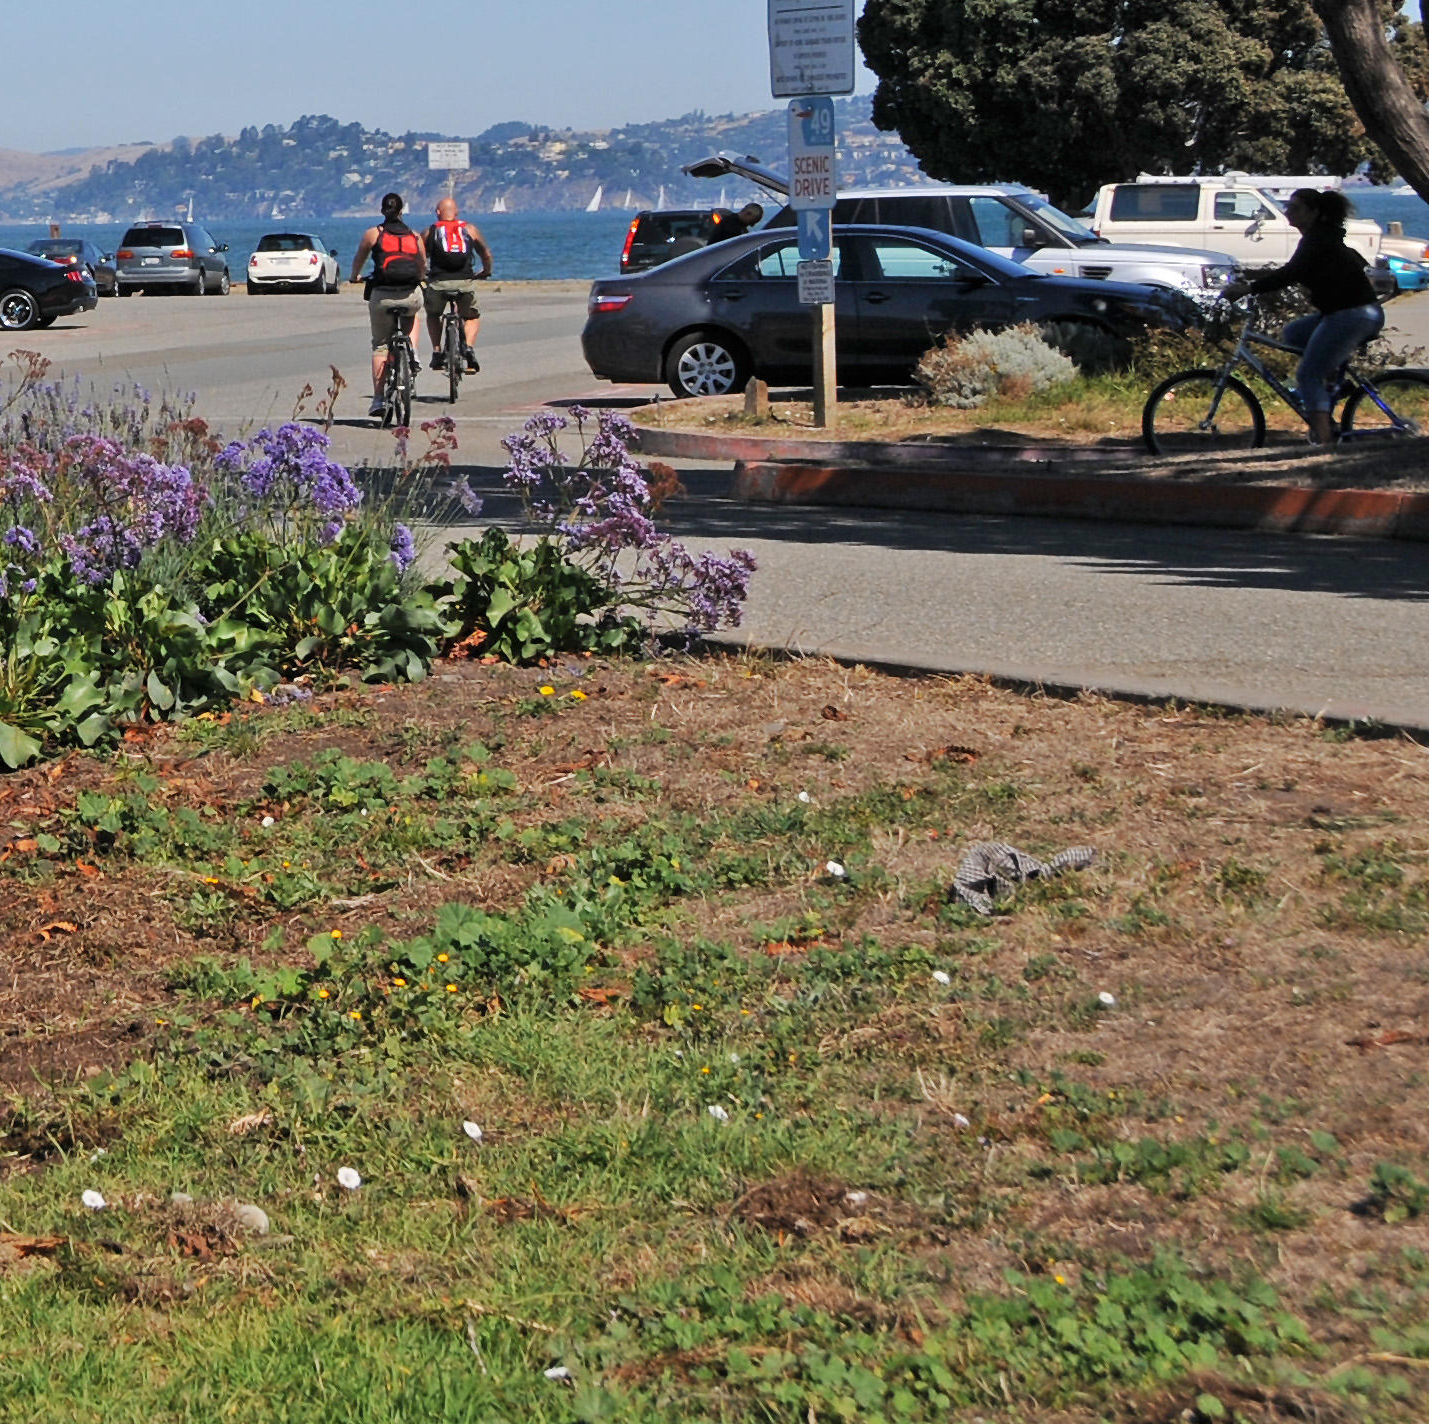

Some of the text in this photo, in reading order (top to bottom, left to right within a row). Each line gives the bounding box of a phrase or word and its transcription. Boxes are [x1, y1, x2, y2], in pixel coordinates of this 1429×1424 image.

[811, 108, 831, 135] 49
[794, 156, 829, 175] SCENIC
[794, 178, 830, 197] DRIVE
